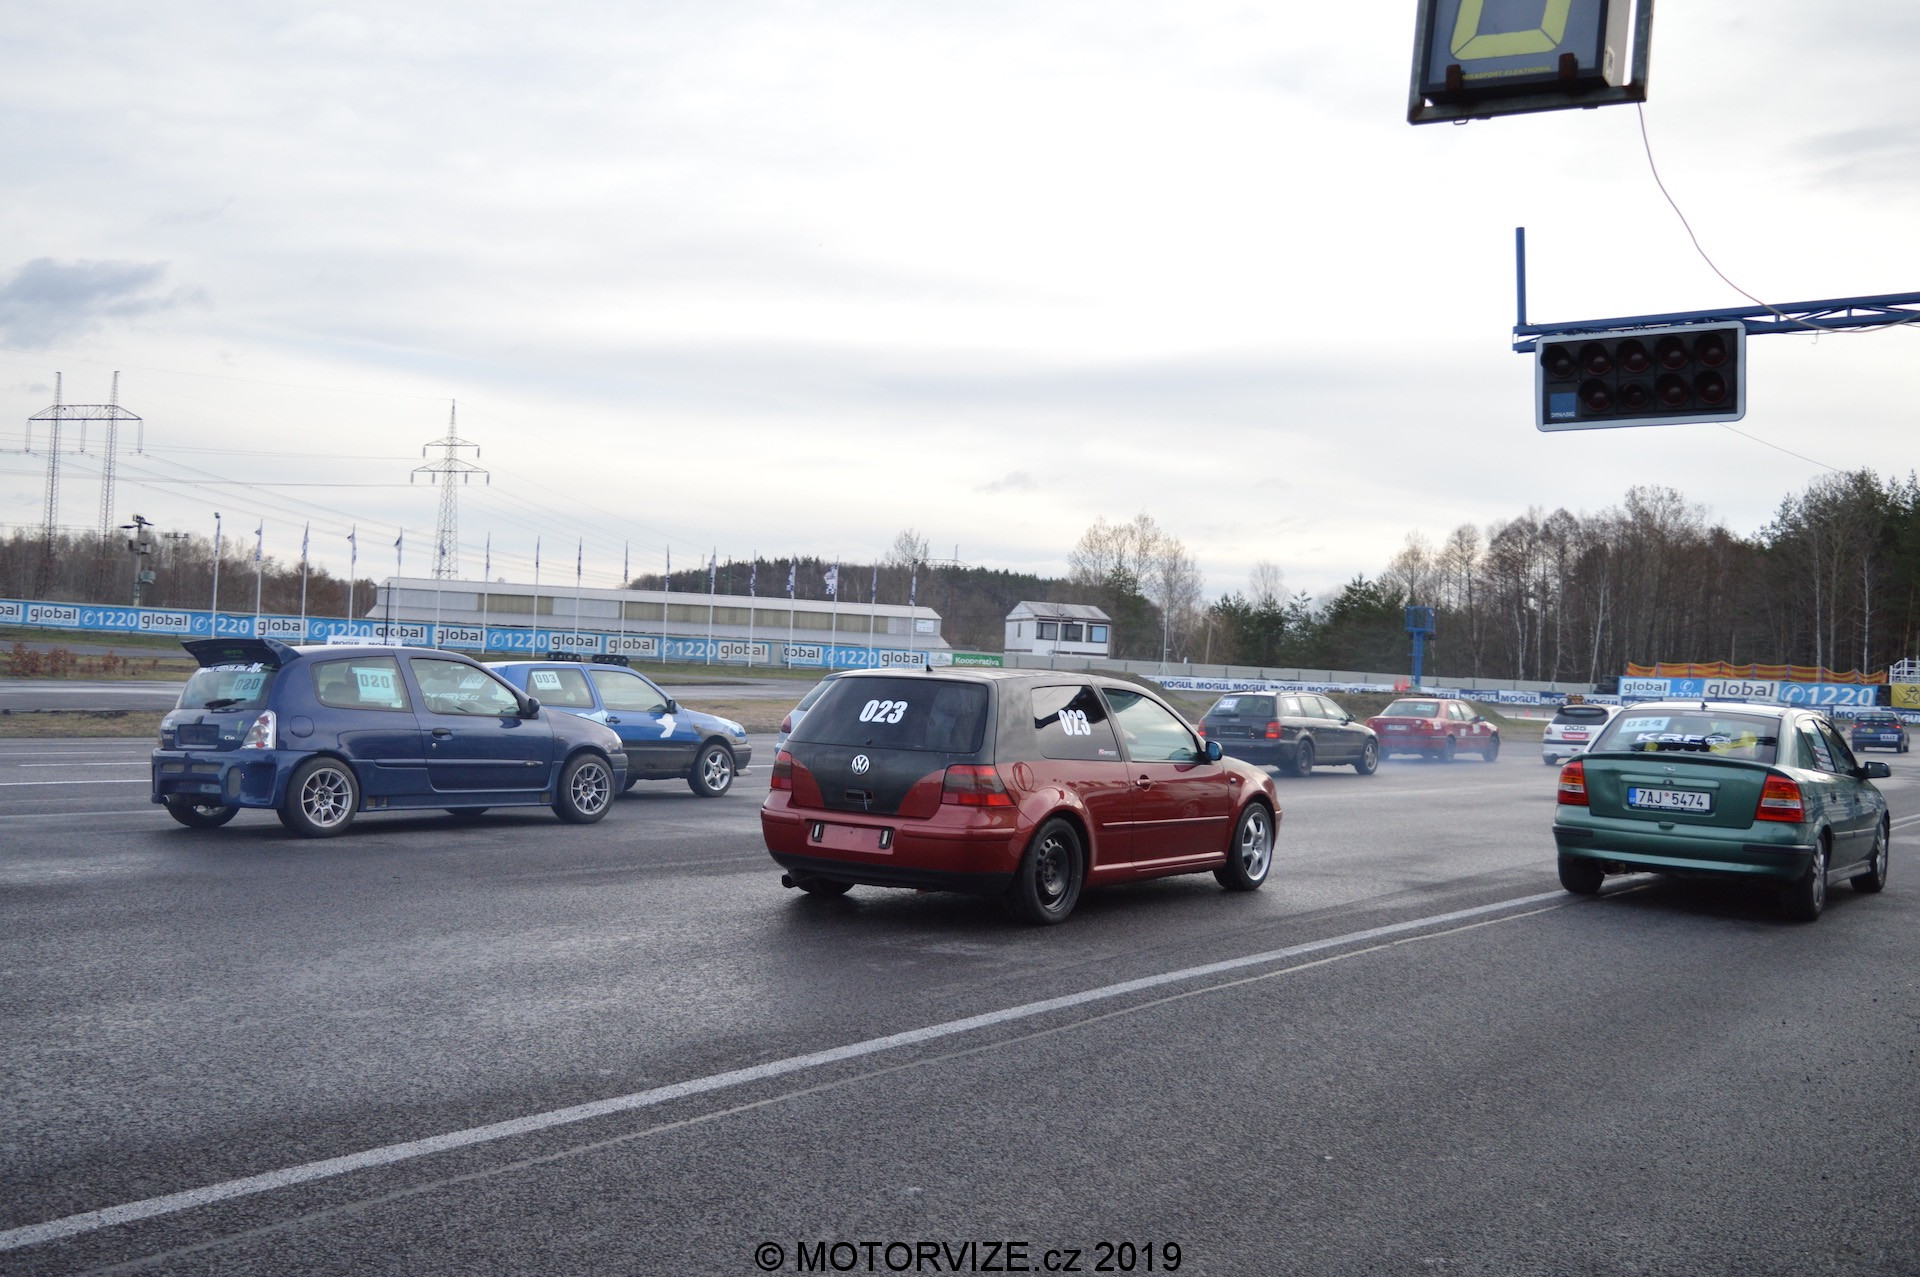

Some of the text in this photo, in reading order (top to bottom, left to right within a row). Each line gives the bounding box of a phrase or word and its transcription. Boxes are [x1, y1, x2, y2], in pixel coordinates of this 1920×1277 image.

[31, 606, 76, 622] global
[97, 611, 137, 627] 1220
[142, 613, 187, 629] global
[258, 619, 306, 636] global
[437, 628, 484, 644] global
[505, 633, 547, 649] 1220
[552, 634, 599, 650] global
[609, 638, 655, 653] global
[676, 641, 717, 658] 1220
[839, 650, 878, 666] 1220
[882, 652, 924, 667] global
[360, 673, 390, 689] 020
[534, 673, 558, 684] 003
[1160, 680, 1193, 690] MOGUL
[1196, 681, 1232, 691] MOGUL
[1233, 683, 1268, 692] MOGUL
[1461, 692, 1499, 702] MOGUL
[1501, 695, 1539, 704] MOGUL
[1540, 696, 1568, 706] MOG
[1624, 682, 1667, 694] global
[1707, 681, 1775, 698] global
[1808, 685, 1874, 707] 1220
[859, 699, 908, 724] 023
[1058, 709, 1091, 736] 023
[1639, 790, 1704, 807] 7AJ 5474
